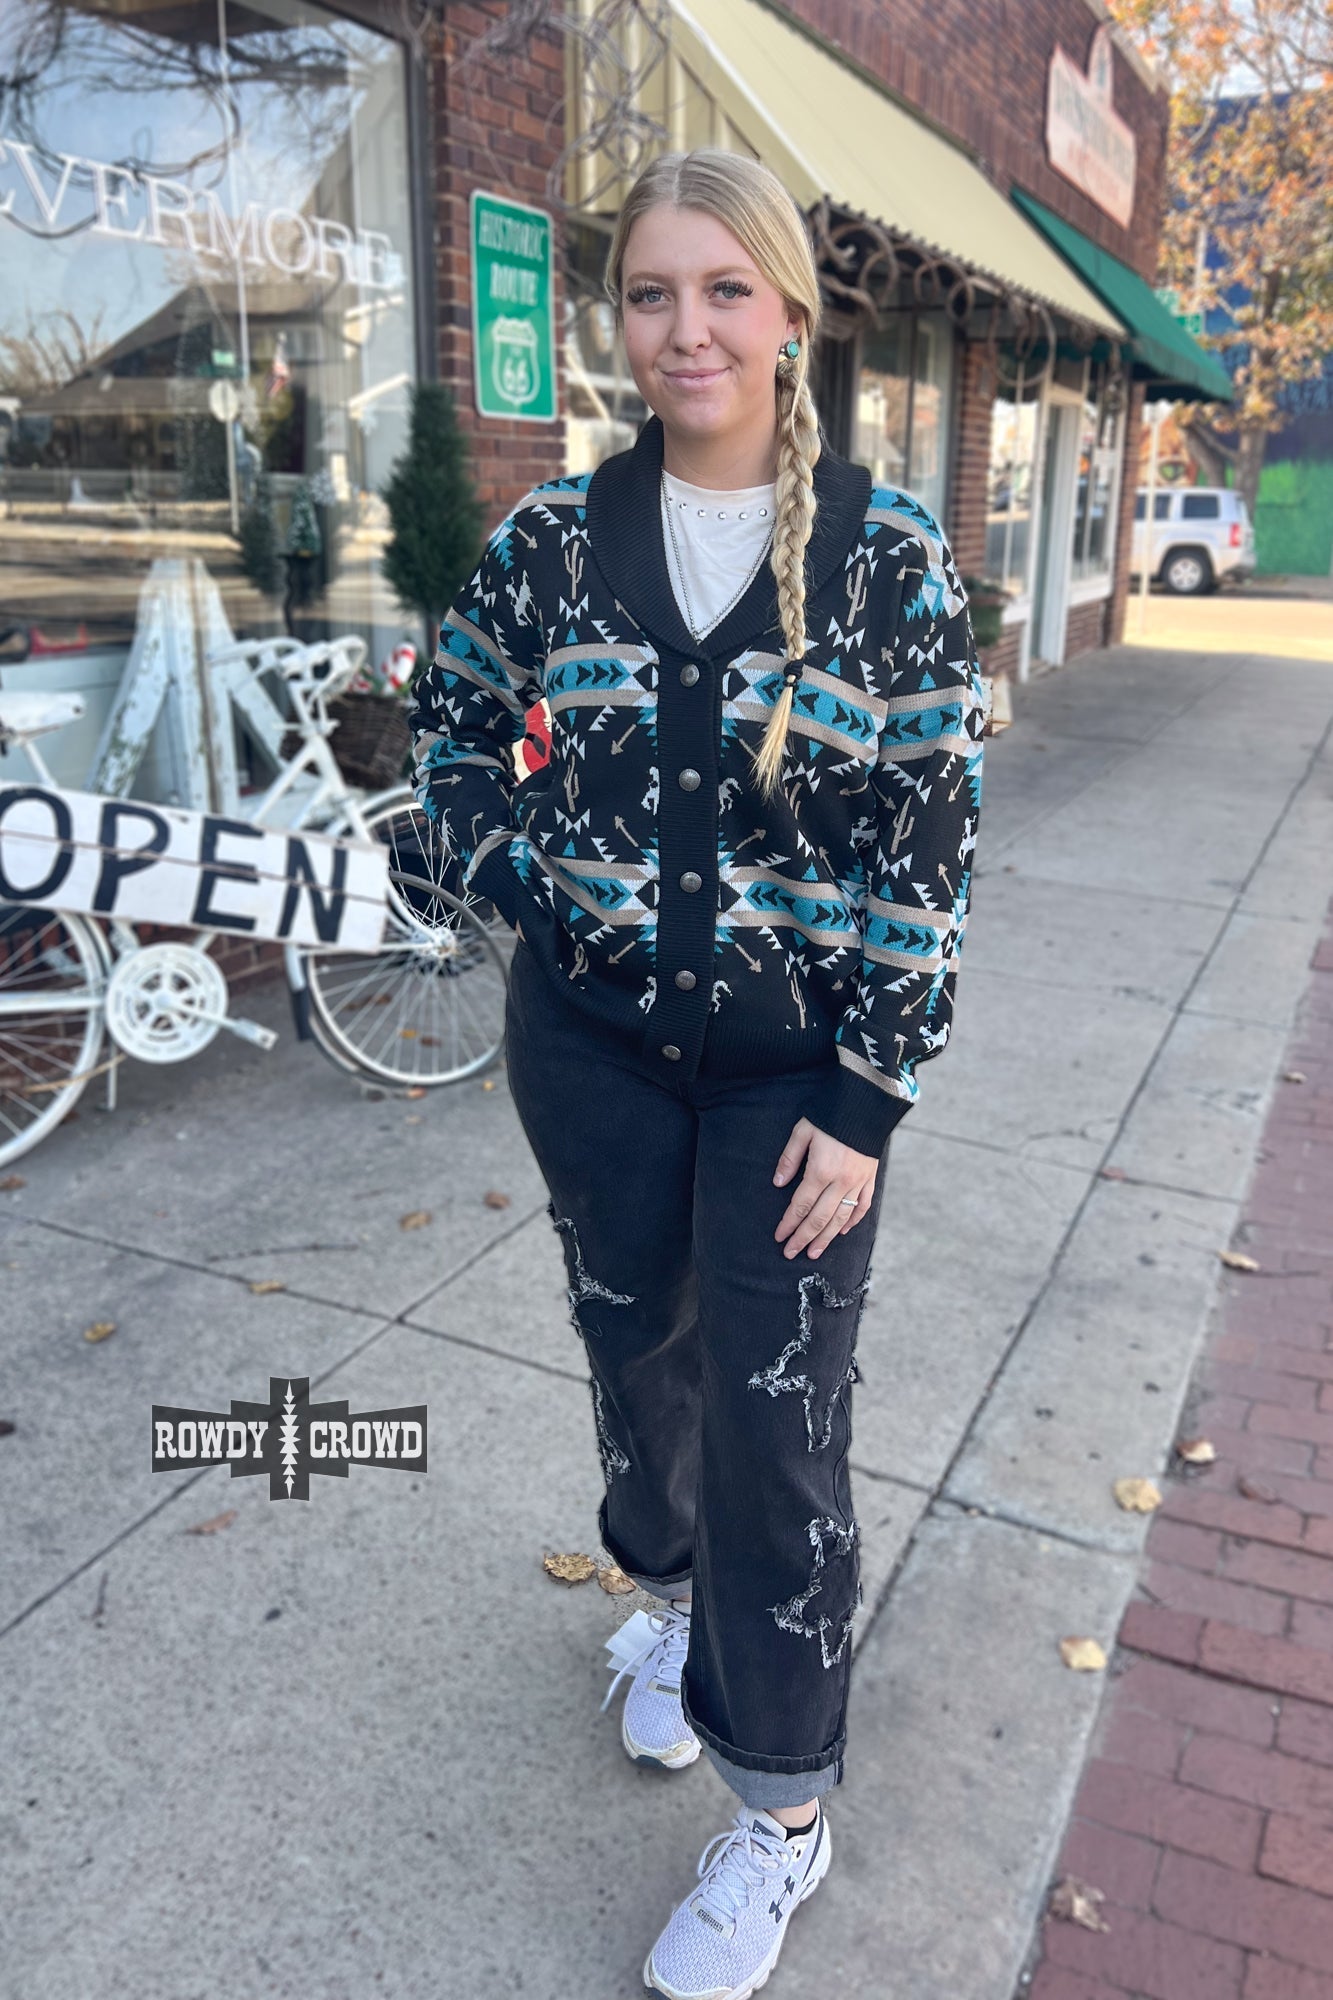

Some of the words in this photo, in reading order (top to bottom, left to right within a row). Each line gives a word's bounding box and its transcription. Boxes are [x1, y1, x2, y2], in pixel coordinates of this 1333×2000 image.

[479, 210, 545, 262] HISTORIC
[490, 262, 538, 306] ROUTE
[503, 357, 531, 394] 66
[0, 788, 348, 942] OPEN
